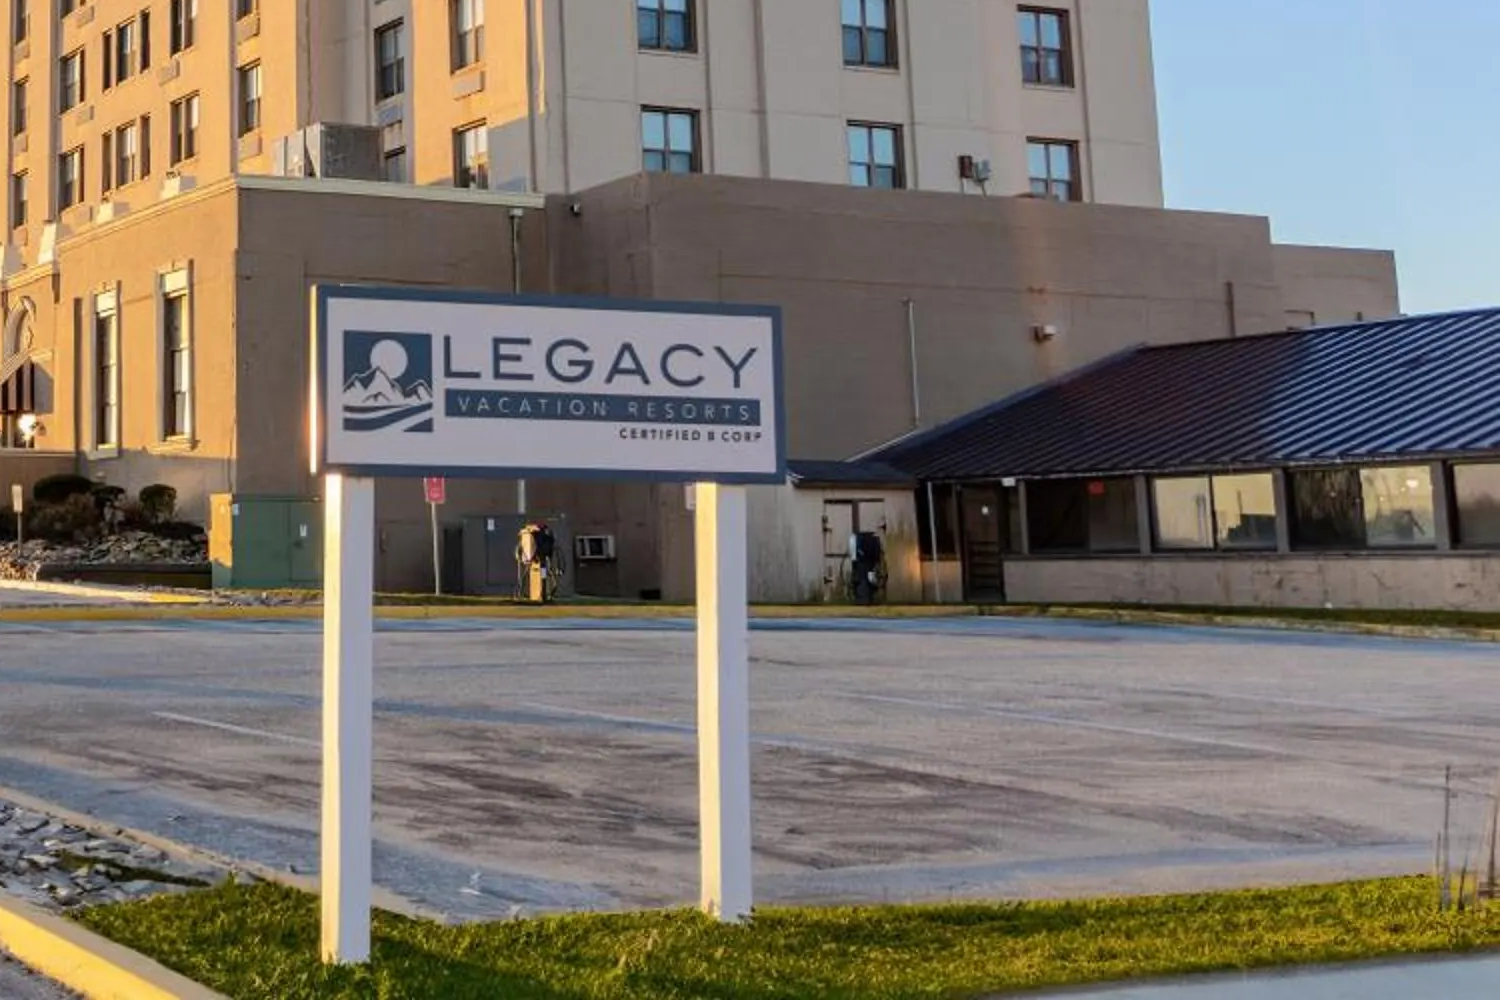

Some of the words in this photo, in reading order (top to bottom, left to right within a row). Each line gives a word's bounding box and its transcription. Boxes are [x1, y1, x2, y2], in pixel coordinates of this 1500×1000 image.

[443, 334, 758, 389] LEGACY
[457, 396, 607, 417] VACATION
[627, 401, 750, 421] RESORTS
[619, 427, 701, 441] CERTIFIED
[721, 431, 762, 442] CORP
